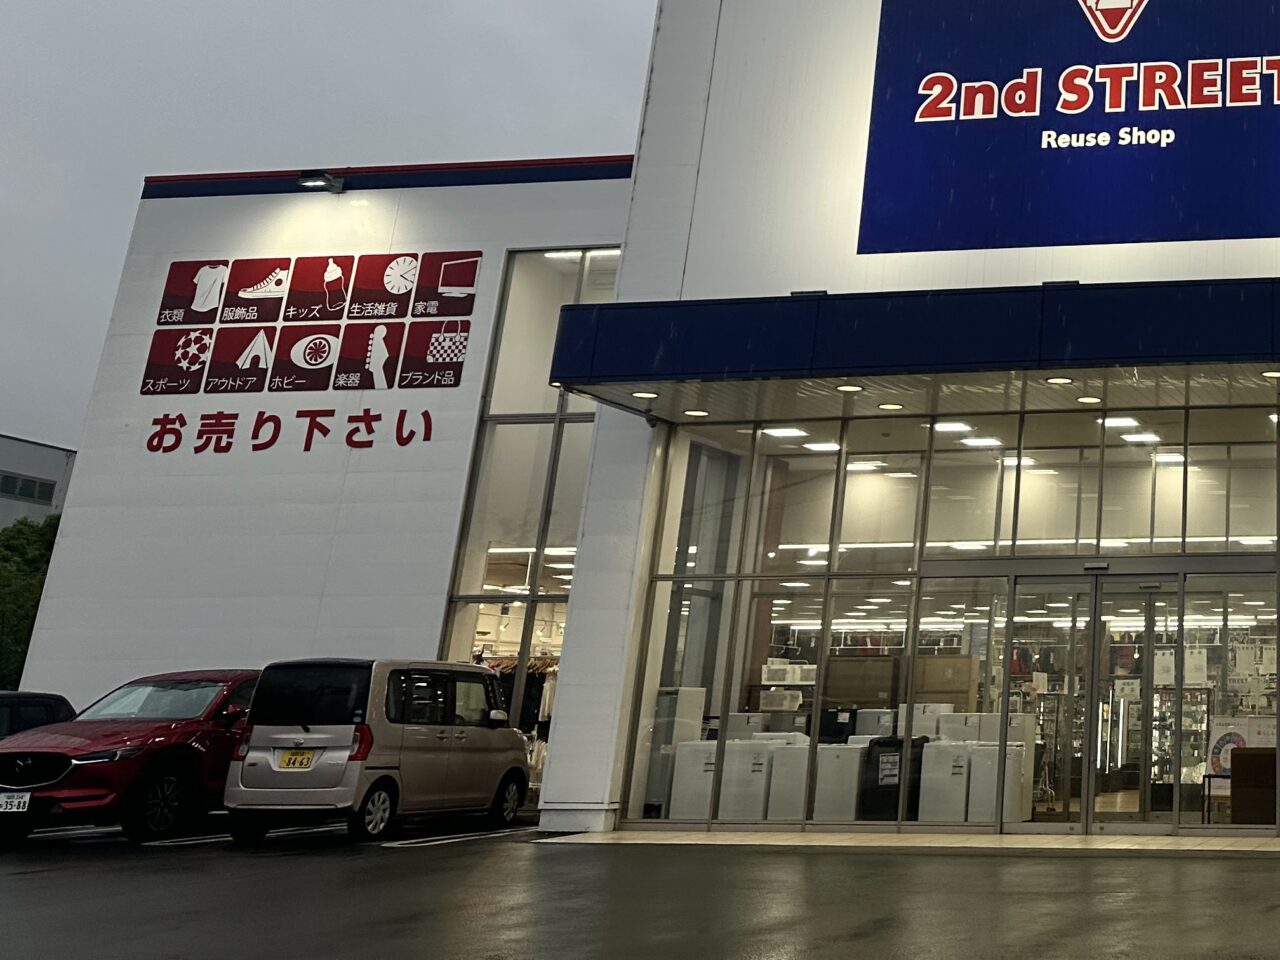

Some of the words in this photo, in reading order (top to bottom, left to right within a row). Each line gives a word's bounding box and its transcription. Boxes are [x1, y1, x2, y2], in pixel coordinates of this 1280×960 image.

[915, 68, 1043, 123] 2nd
[1041, 130, 1111, 149] Reuse
[1117, 126, 1176, 150] Shop
[160, 307, 185, 323] 衣類
[221, 307, 259, 321] 服飾品
[285, 304, 321, 318] キッズ
[349, 302, 398, 317] 生活雑貨
[414, 300, 439, 315] 家電
[143, 378, 191, 391] スポーツ
[207, 376, 257, 390] アウトドア
[270, 375, 306, 389] ホビー
[335, 373, 360, 387] 楽器
[400, 370, 455, 386] ブランド品
[146, 408, 433, 454] お売り下さい
